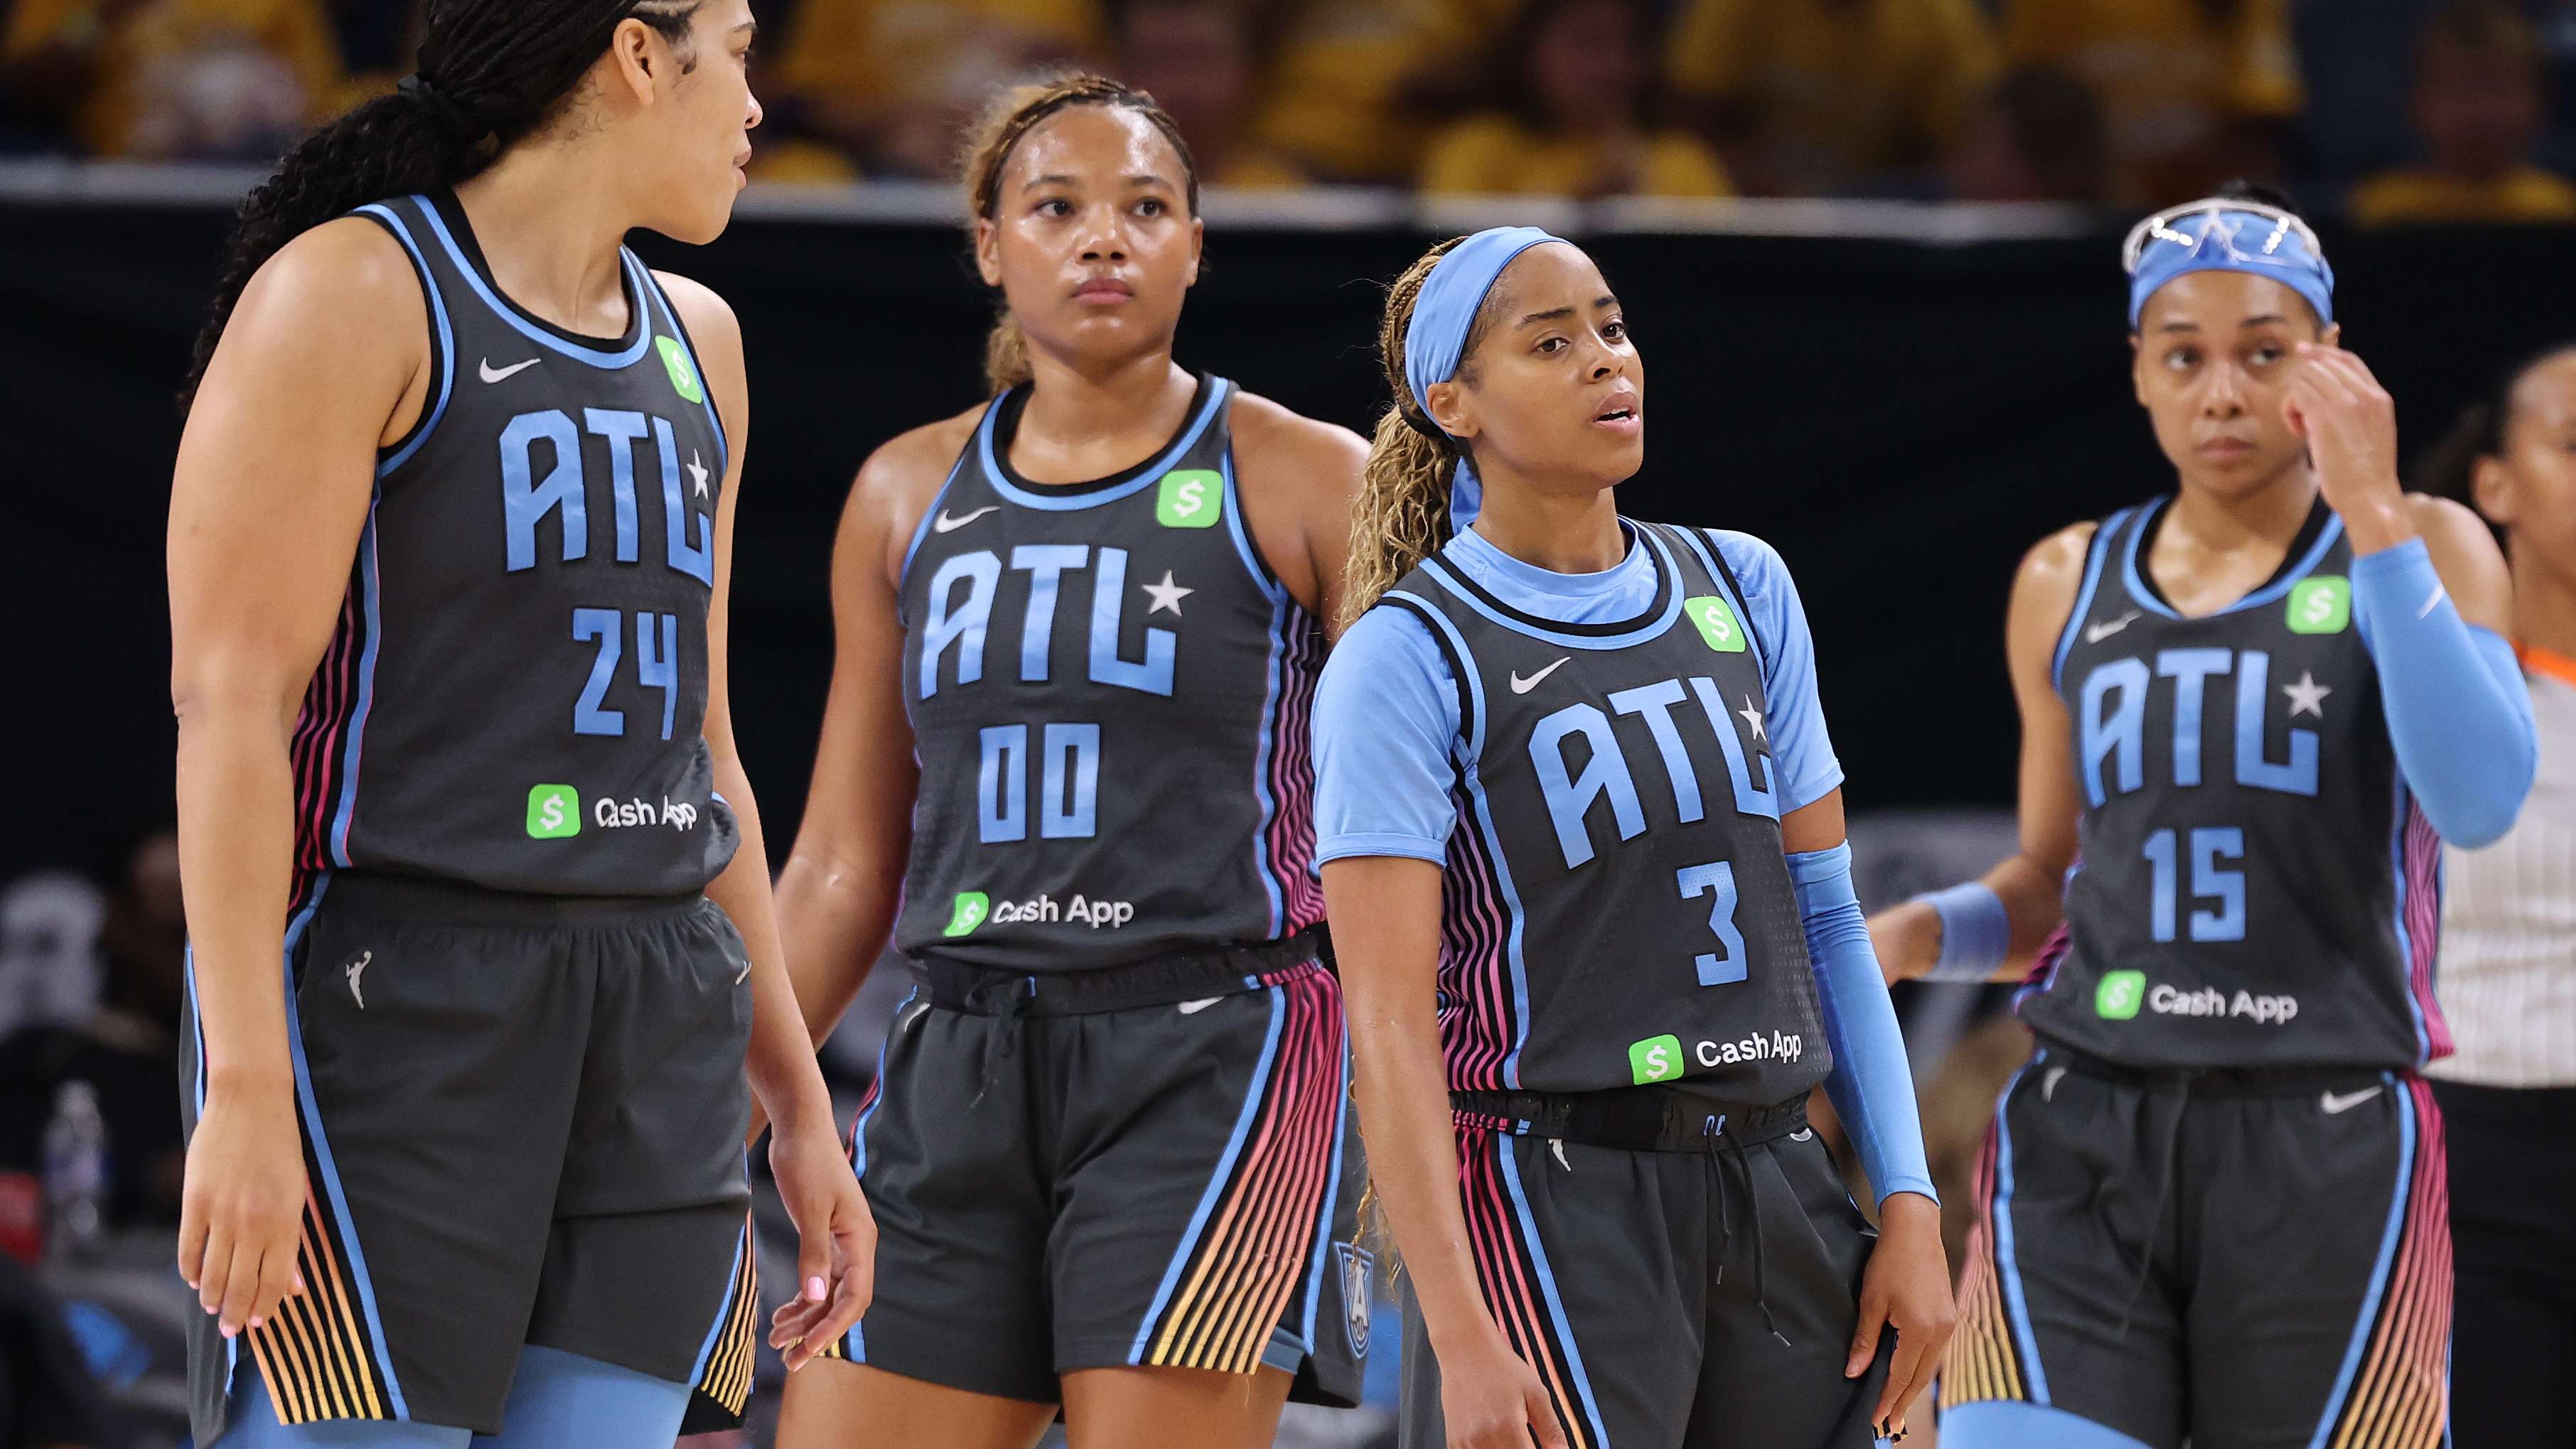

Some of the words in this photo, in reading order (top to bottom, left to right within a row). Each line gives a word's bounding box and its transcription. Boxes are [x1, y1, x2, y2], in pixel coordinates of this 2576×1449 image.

[499, 407, 713, 587] ATL
[573, 608, 678, 740] 24
[921, 544, 1176, 700] ATL
[980, 723, 1100, 844] 00
[1528, 677, 1780, 869] ATL
[2080, 647, 2319, 809] ATL
[594, 797, 657, 828] Cash
[661, 794, 698, 832] App
[992, 894, 1059, 924] Cash
[1066, 894, 1134, 929] App
[1676, 861, 1748, 986] 3
[2144, 826, 2246, 942] 15
[1696, 1032, 1769, 1067] Cash
[1771, 1029, 1802, 1064] App
[2149, 984, 2226, 1017] Cash
[2229, 989, 2299, 1025] App
